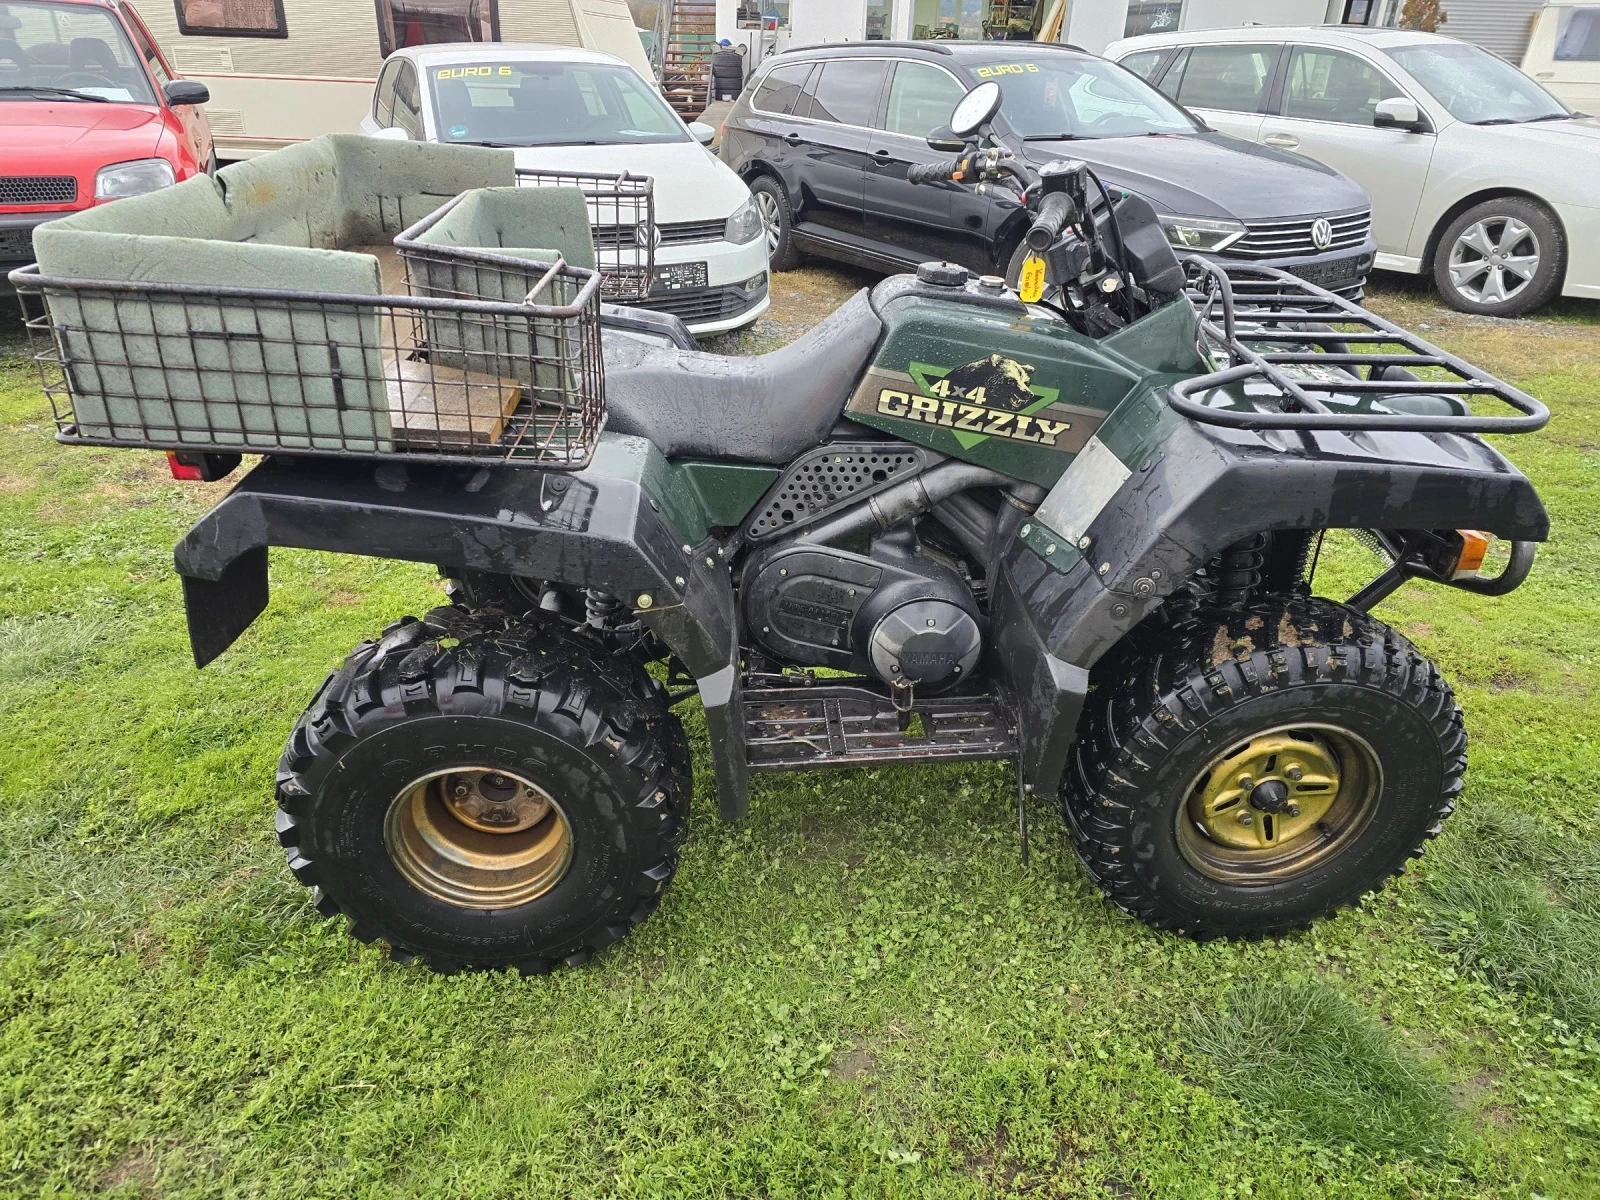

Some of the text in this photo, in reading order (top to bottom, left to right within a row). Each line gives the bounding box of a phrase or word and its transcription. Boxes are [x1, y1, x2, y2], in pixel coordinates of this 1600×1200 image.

[498, 66, 512, 76] 6
[1025, 63, 1040, 73] 6
[930, 379, 987, 405] 4x4
[877, 388, 1072, 446] GRIZZLY
[902, 651, 956, 665] YAMAHA
